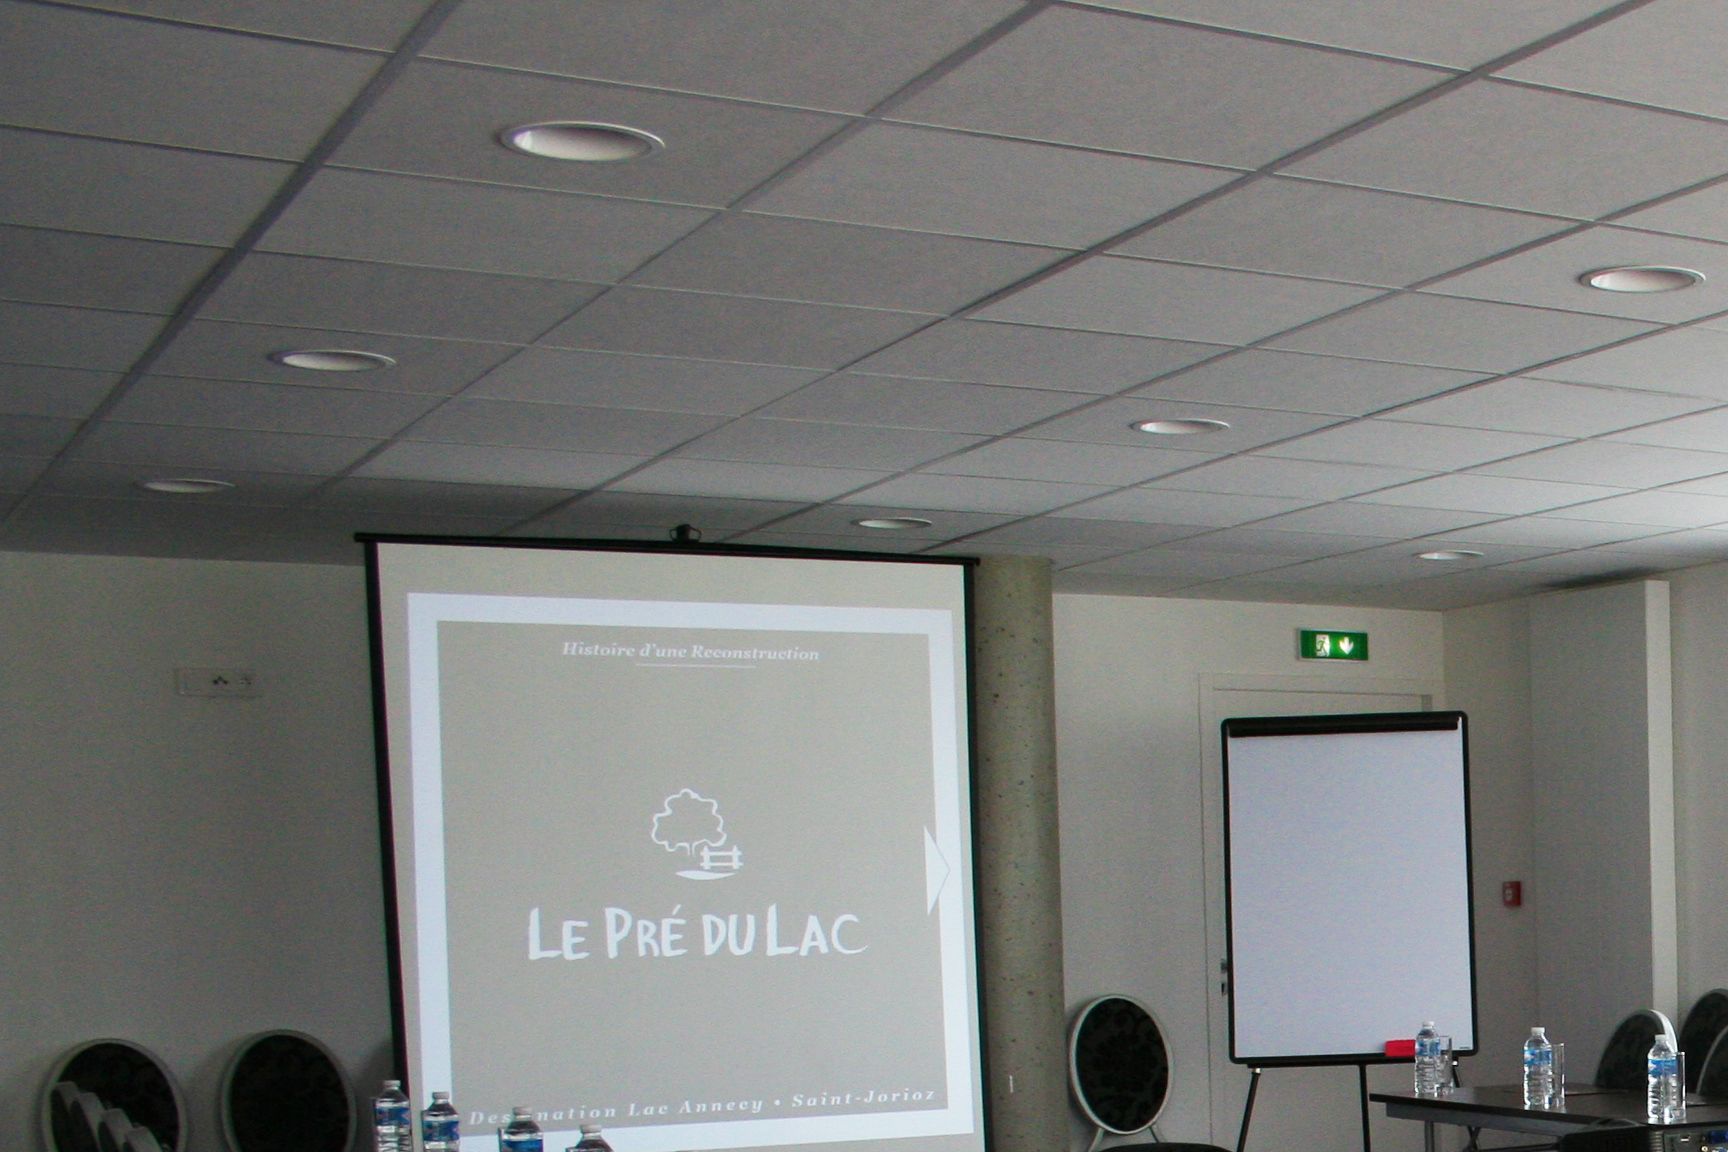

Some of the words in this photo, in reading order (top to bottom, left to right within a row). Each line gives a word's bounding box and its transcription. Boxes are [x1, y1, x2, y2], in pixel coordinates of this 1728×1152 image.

[563, 642, 635, 657] Histoire
[640, 642, 688, 659] d'une
[691, 644, 820, 661] Reconstruction
[528, 906, 590, 961] LE
[604, 903, 688, 960] PRÉ
[702, 913, 756, 956] DU
[765, 902, 869, 957] LAC
[469, 1104, 617, 1126] Desnation
[629, 1102, 669, 1117] Lac
[679, 1099, 763, 1115] Annecy
[791, 1087, 936, 1108] Saint-Jorioz
